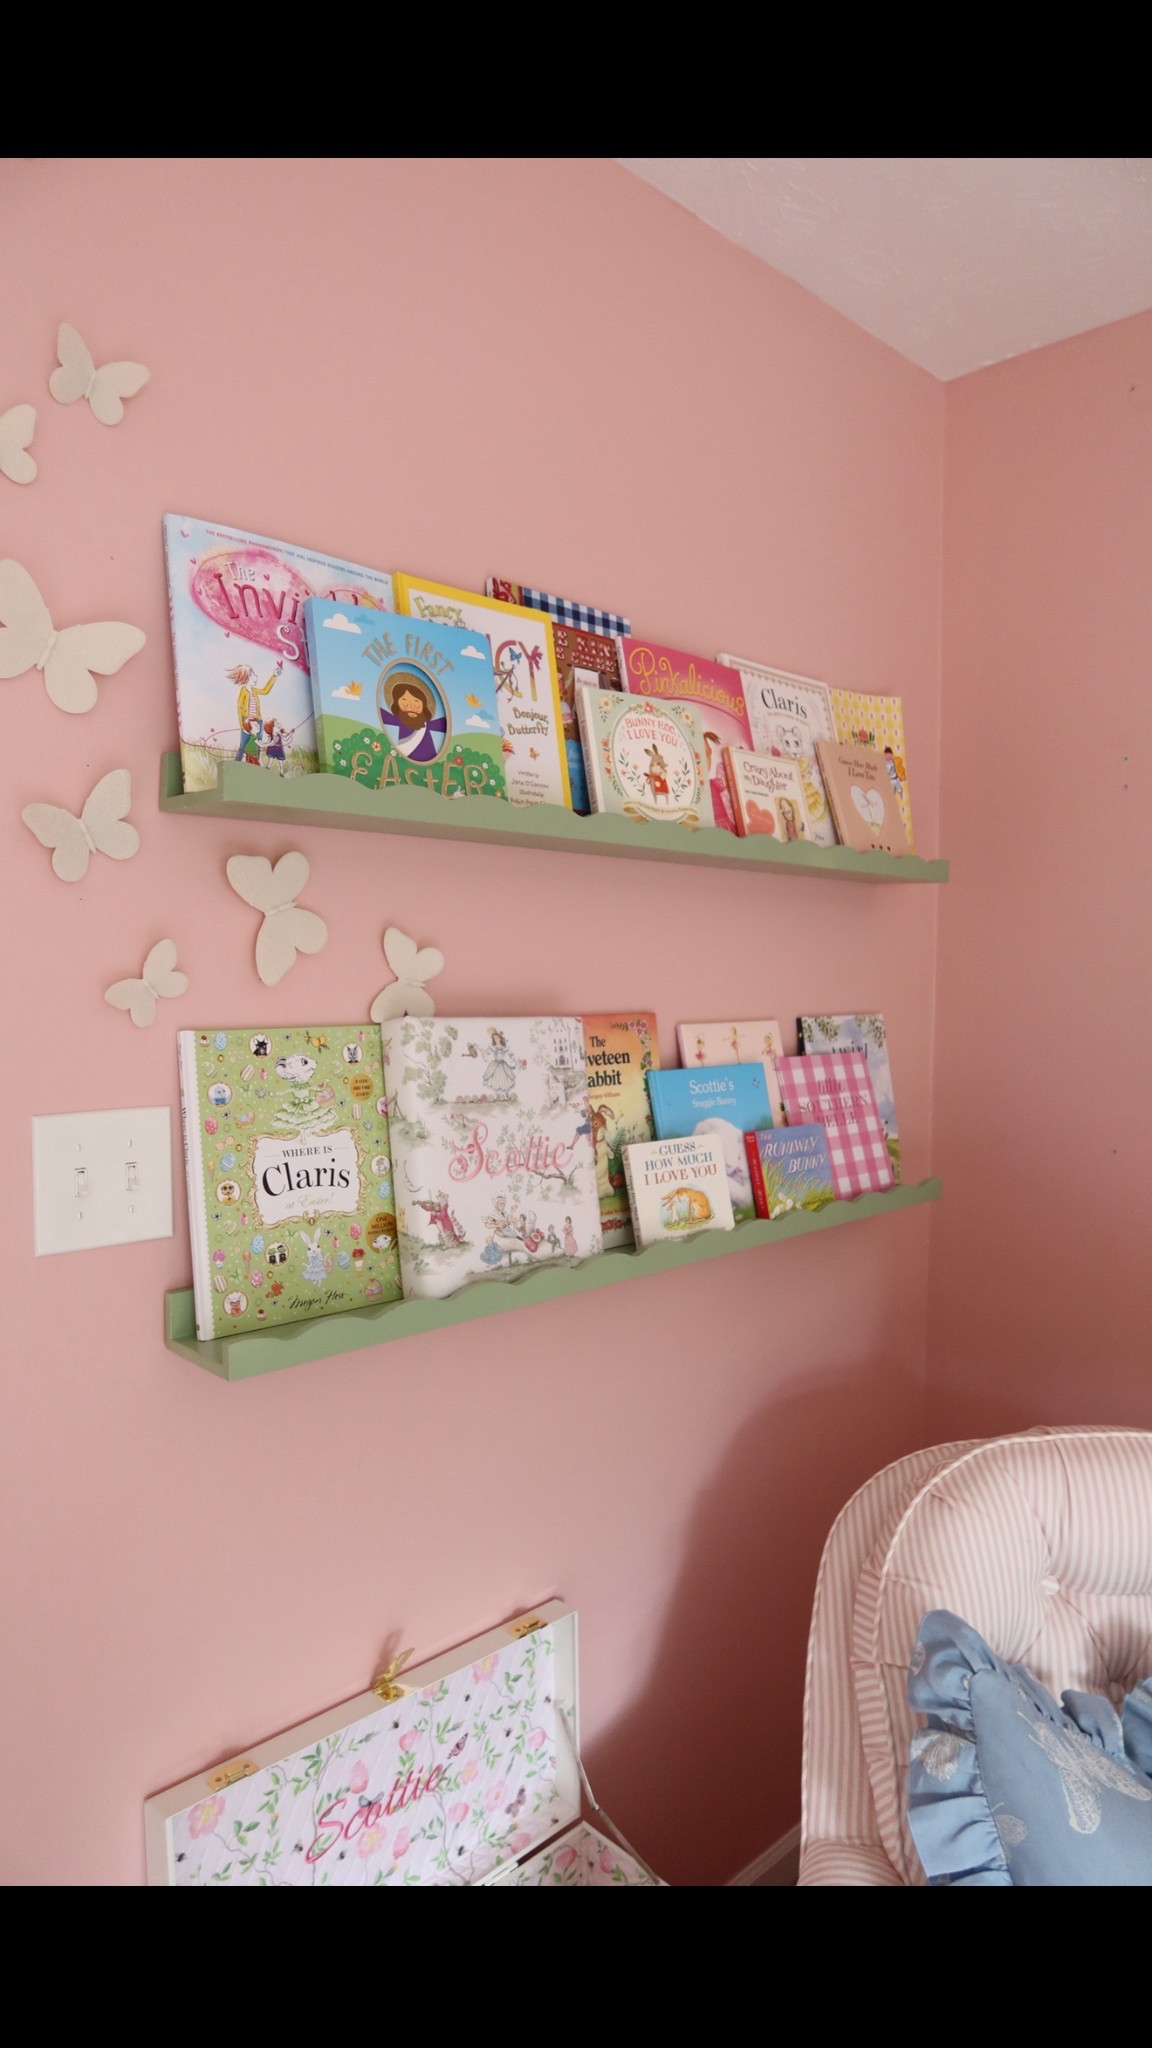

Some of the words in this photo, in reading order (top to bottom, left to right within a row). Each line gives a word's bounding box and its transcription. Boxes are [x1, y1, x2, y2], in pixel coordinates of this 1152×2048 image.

[413, 595, 463, 620] Fancy
[360, 632, 398, 666] THE
[405, 633, 456, 675] FIRST
[629, 645, 746, 717] Pinkalicious
[760, 687, 808, 719] Claris
[512, 706, 550, 725] Bonjour,
[624, 718, 656, 729] BUNNY
[506, 721, 549, 737] Butterfly
[627, 730, 633, 740] I
[633, 729, 657, 740] LOVE
[659, 732, 679, 747] YOU
[743, 761, 769, 778] Crazy
[769, 766, 794, 781] About
[751, 774, 788, 793] Daughter
[589, 1035, 606, 1048] The
[586, 1050, 631, 1067] veteen
[587, 1069, 622, 1088] abbit
[688, 1076, 735, 1095] Scottie's
[282, 1146, 321, 1158] WHERE
[323, 1145, 333, 1154] IS
[447, 1121, 575, 1184] Scottie
[658, 1141, 696, 1157] GUESS
[761, 1135, 819, 1159] RUNAWAY
[644, 1158, 676, 1172] HOW
[677, 1151, 713, 1166] MUCH
[787, 1152, 828, 1175] BUNNY
[262, 1158, 350, 1197] Claris
[644, 1173, 650, 1186] I
[654, 1168, 689, 1185] LOVE
[690, 1163, 718, 1179] YOU
[305, 1764, 447, 1865] Scottie
